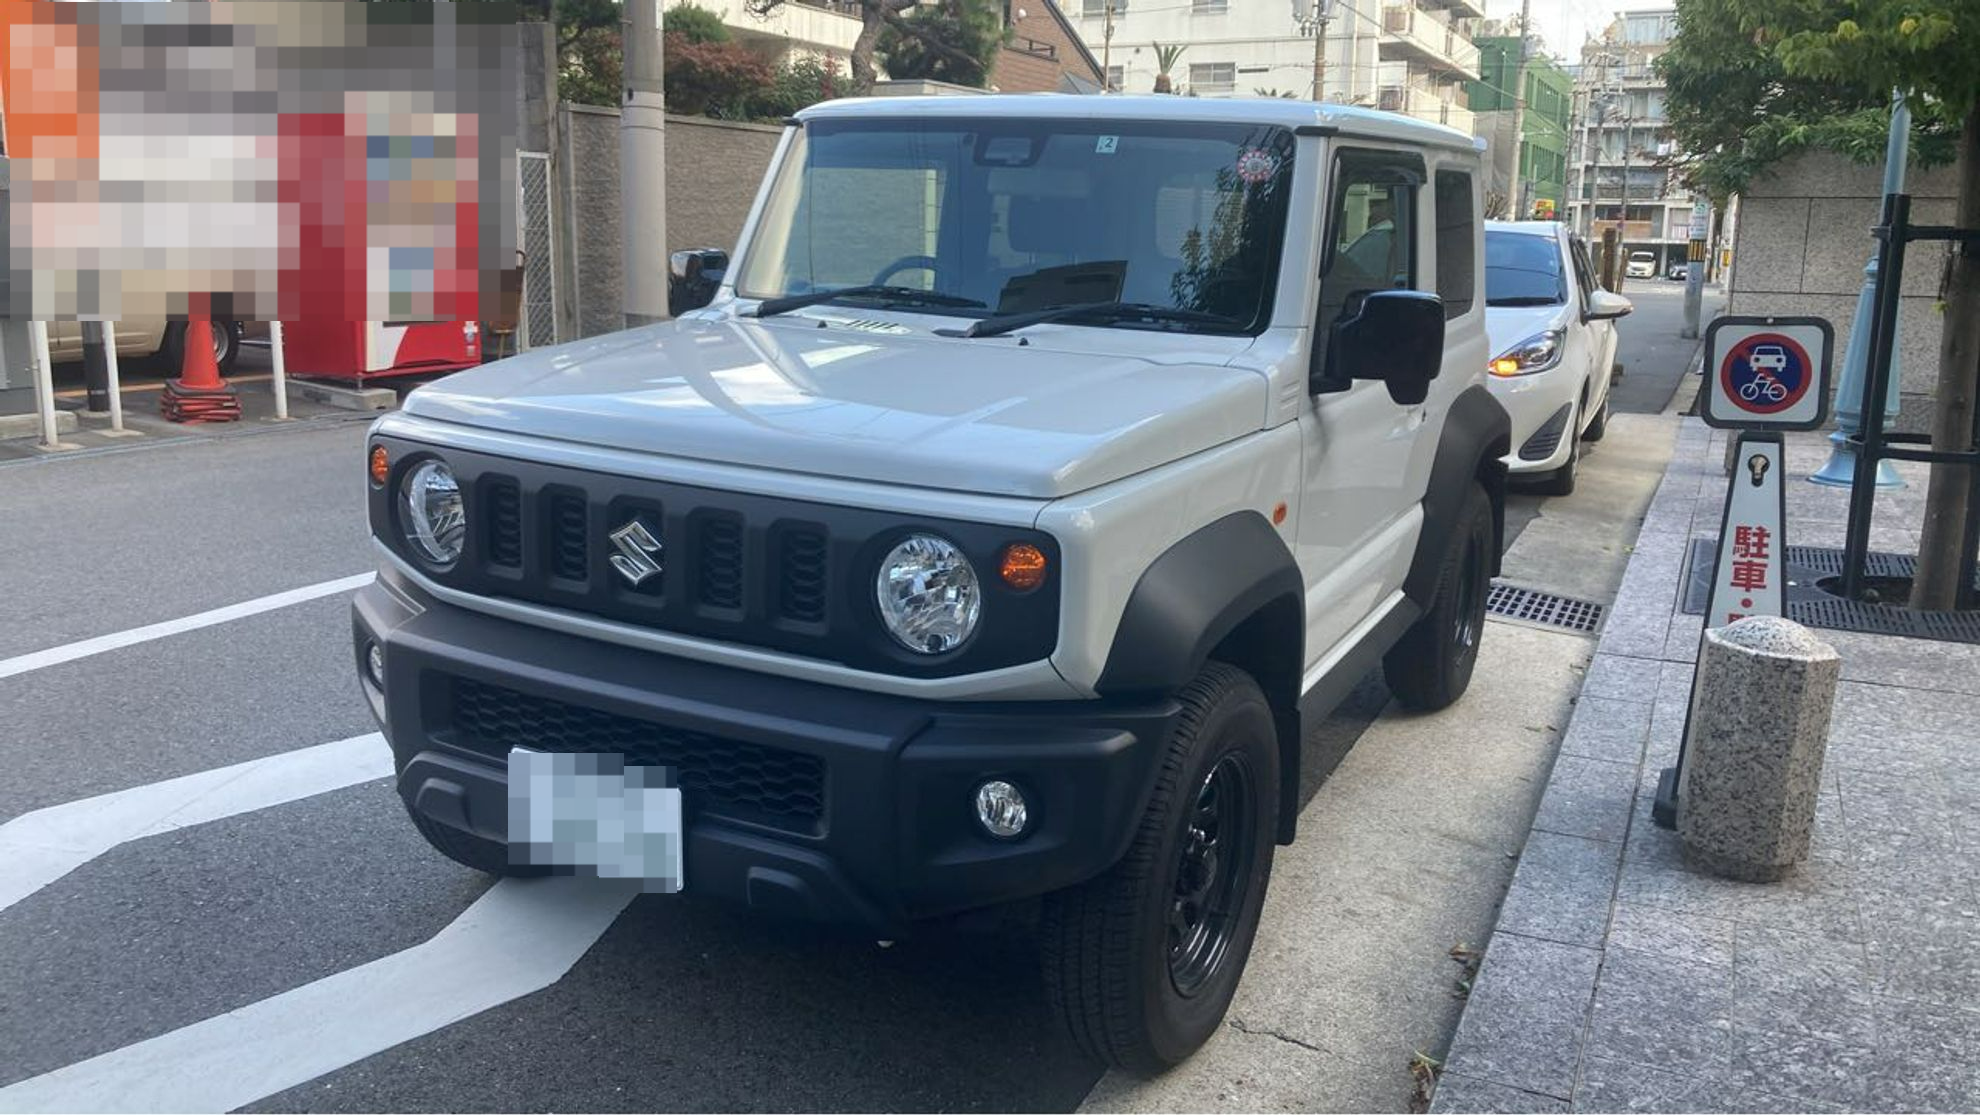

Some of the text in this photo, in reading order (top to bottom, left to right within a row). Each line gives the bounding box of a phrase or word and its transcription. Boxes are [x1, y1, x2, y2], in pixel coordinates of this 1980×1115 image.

[1104, 138, 1113, 148] 2
[1728, 525, 1770, 624] 駐車・
